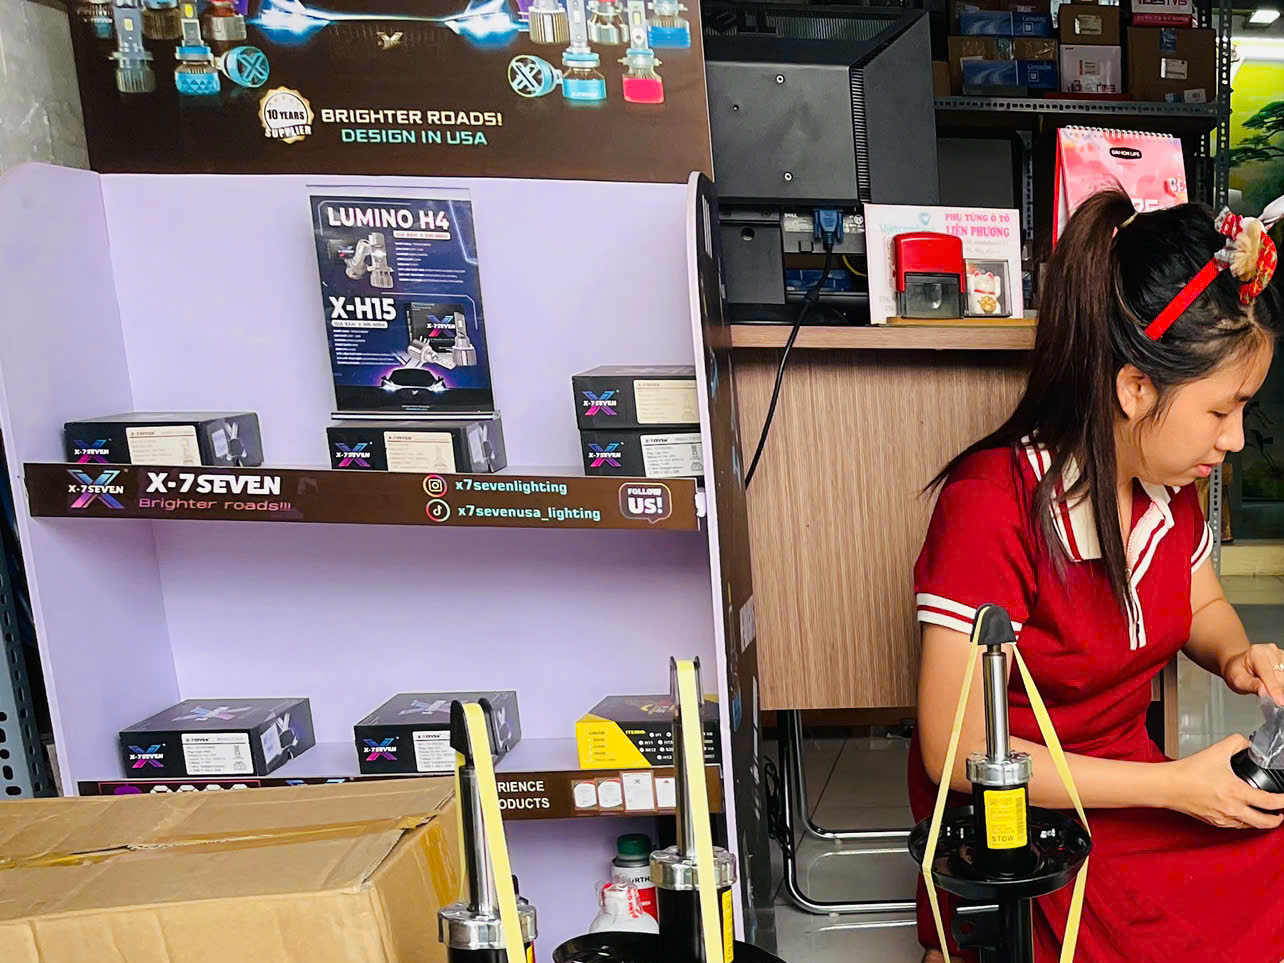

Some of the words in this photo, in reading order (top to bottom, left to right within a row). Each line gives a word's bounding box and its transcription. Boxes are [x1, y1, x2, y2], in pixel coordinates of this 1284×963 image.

[267, 109, 278, 120] 10
[279, 111, 305, 121] YEARS
[321, 109, 423, 125] BRIGHTER
[427, 110, 503, 127] ROADS!
[264, 125, 312, 139] SUPPLIER
[341, 129, 416, 144] DESIGN
[422, 130, 442, 144] IN
[447, 131, 488, 145] USA
[327, 206, 414, 229] LUMINO
[418, 210, 450, 230] H4
[328, 296, 397, 321] X-H15
[68, 484, 124, 494] X-7SEVEN
[455, 479, 568, 495] x7sevenlighting
[627, 487, 661, 495] FOLLOW
[138, 498, 214, 511] Brighter
[224, 499, 292, 511] roads!!!
[627, 496, 663, 514] US!
[457, 505, 601, 521] x7sevenusa_lighting
[496, 780, 545, 793] RIENCE
[498, 797, 550, 810] ODUCTS
